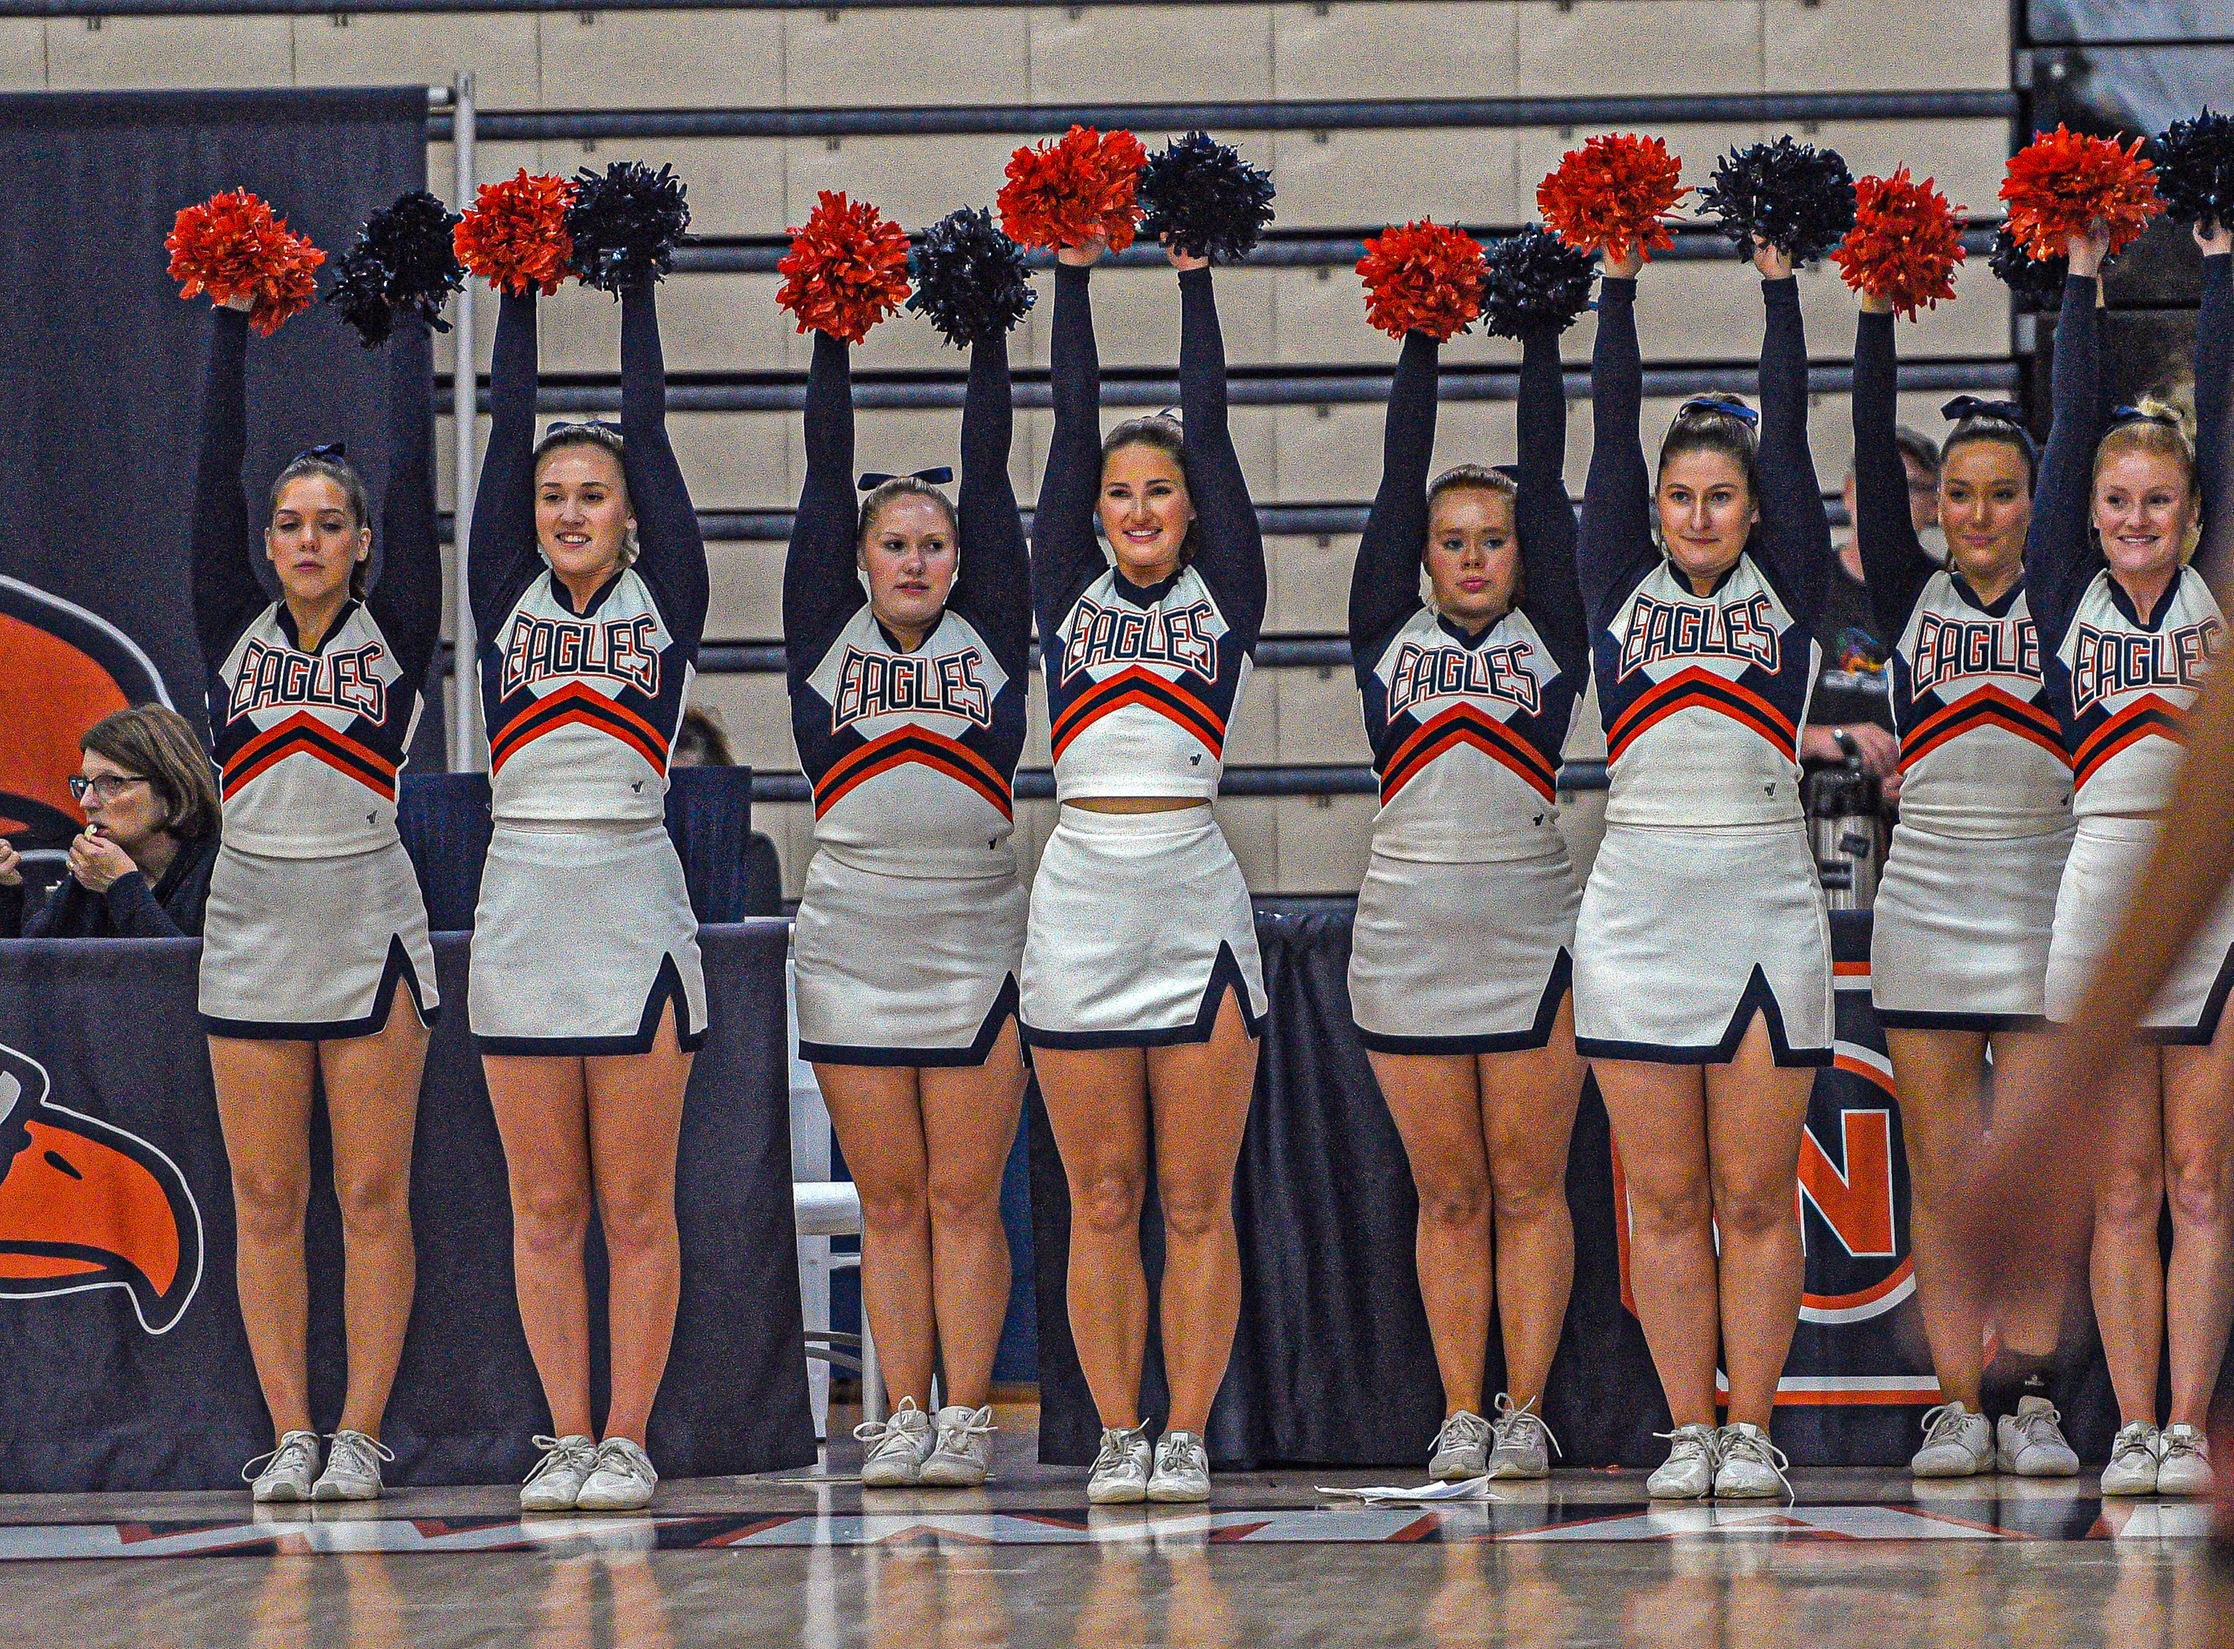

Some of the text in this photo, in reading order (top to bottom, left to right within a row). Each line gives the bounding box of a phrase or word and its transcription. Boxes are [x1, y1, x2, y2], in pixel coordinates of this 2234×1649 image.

[226, 637, 386, 727] EAGLES
[500, 610, 661, 704] EAGLES
[1060, 596, 1218, 688] EAGLES
[1387, 641, 1541, 725] EAGLES
[1616, 591, 1782, 684] EAGLES
[1911, 611, 2041, 703] EAGLE
[831, 643, 993, 735] EAGLES
